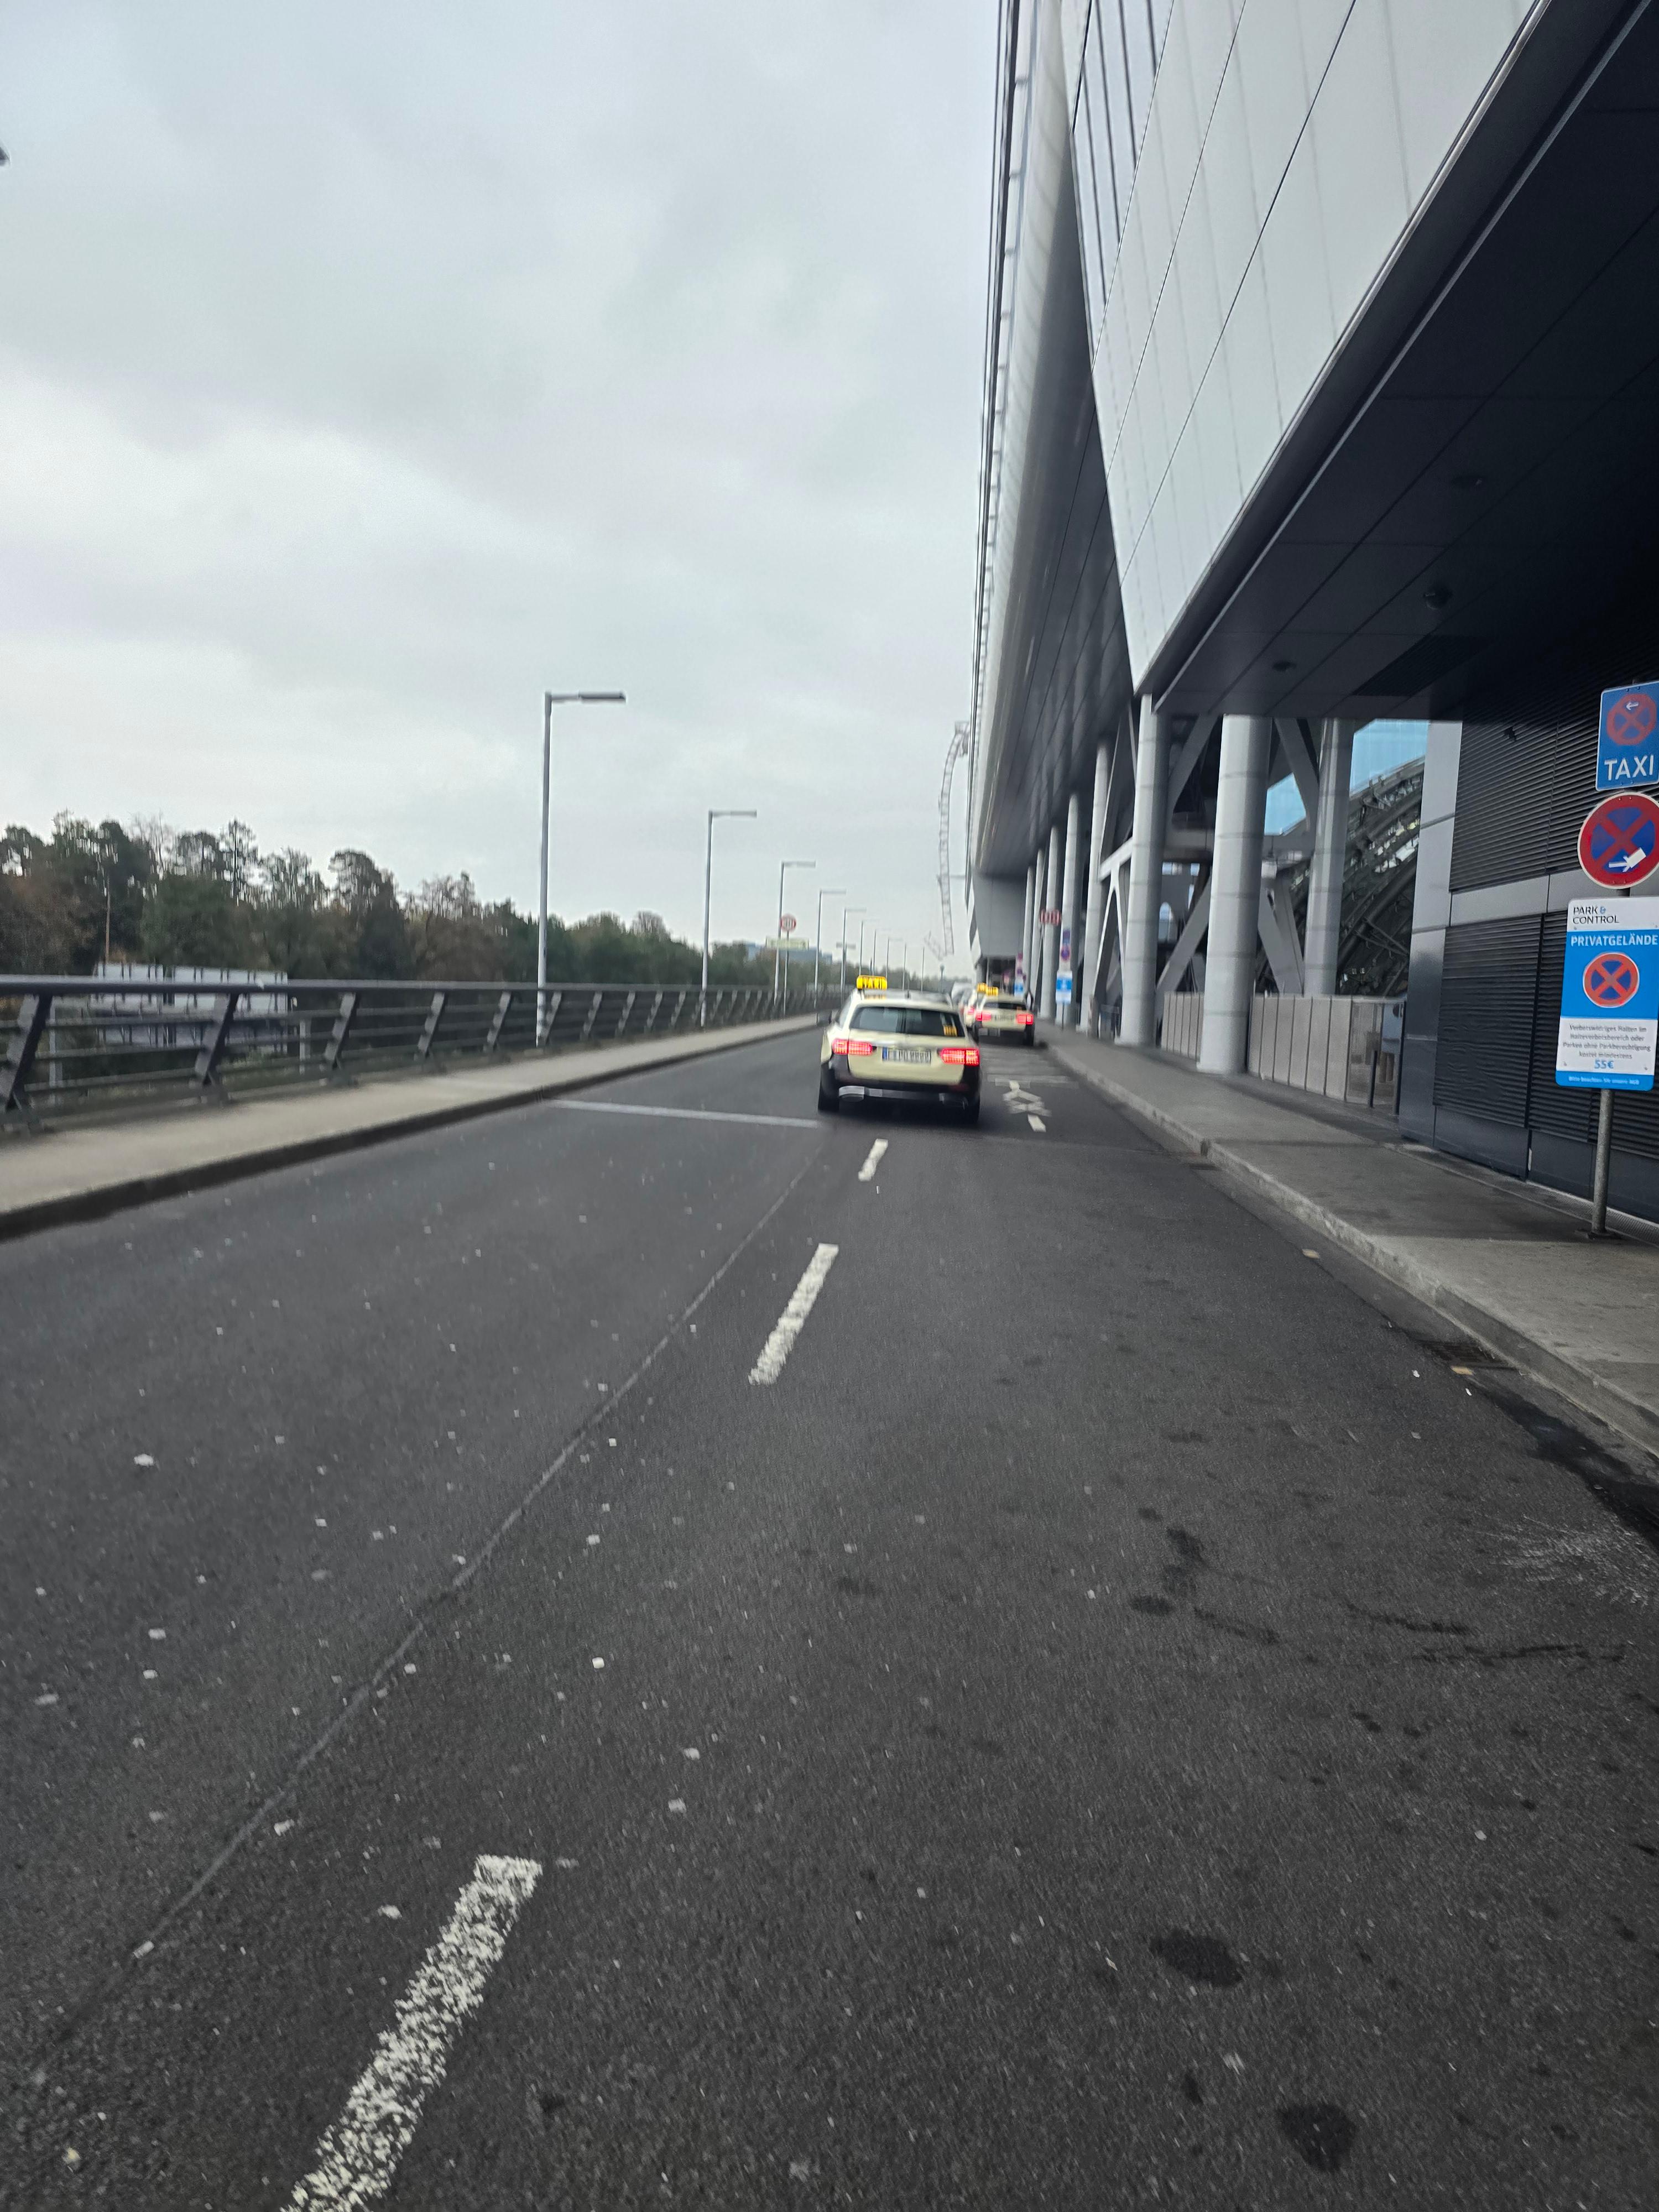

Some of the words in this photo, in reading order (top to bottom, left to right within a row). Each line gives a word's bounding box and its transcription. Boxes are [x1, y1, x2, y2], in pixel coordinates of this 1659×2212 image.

[1604, 754, 1654, 781] TAXI
[1573, 905, 1598, 915] PARK
[1573, 915, 1620, 924] CONTROL
[1571, 932, 1658, 947] PRIVATGELÄNDE
[1594, 1060, 1614, 1069] 55€
